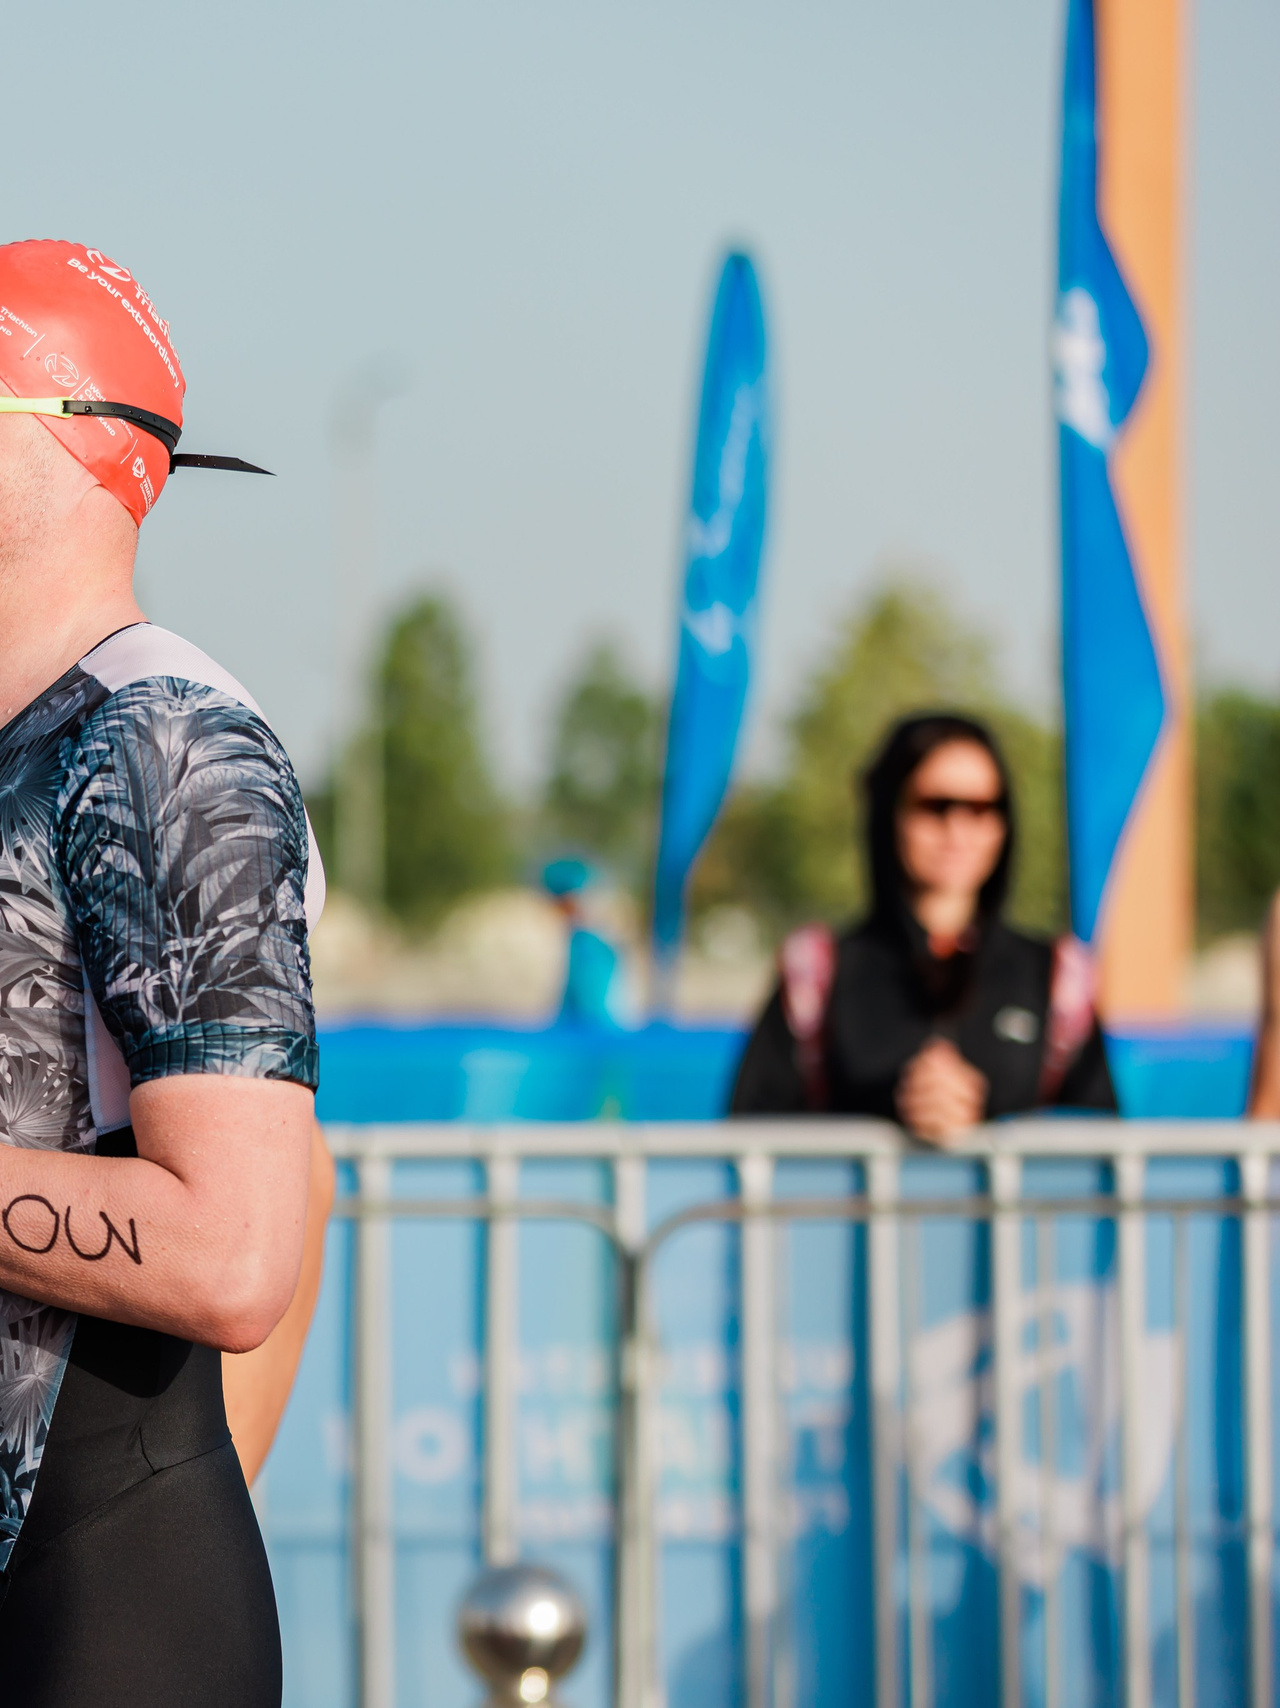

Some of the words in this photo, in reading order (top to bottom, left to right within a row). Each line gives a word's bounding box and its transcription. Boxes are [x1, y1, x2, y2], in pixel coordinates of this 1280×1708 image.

[0, 306, 38, 338] Triathlon
[67, 258, 89, 273] Be
[86, 271, 123, 298] your
[121, 298, 180, 388] extraordinary
